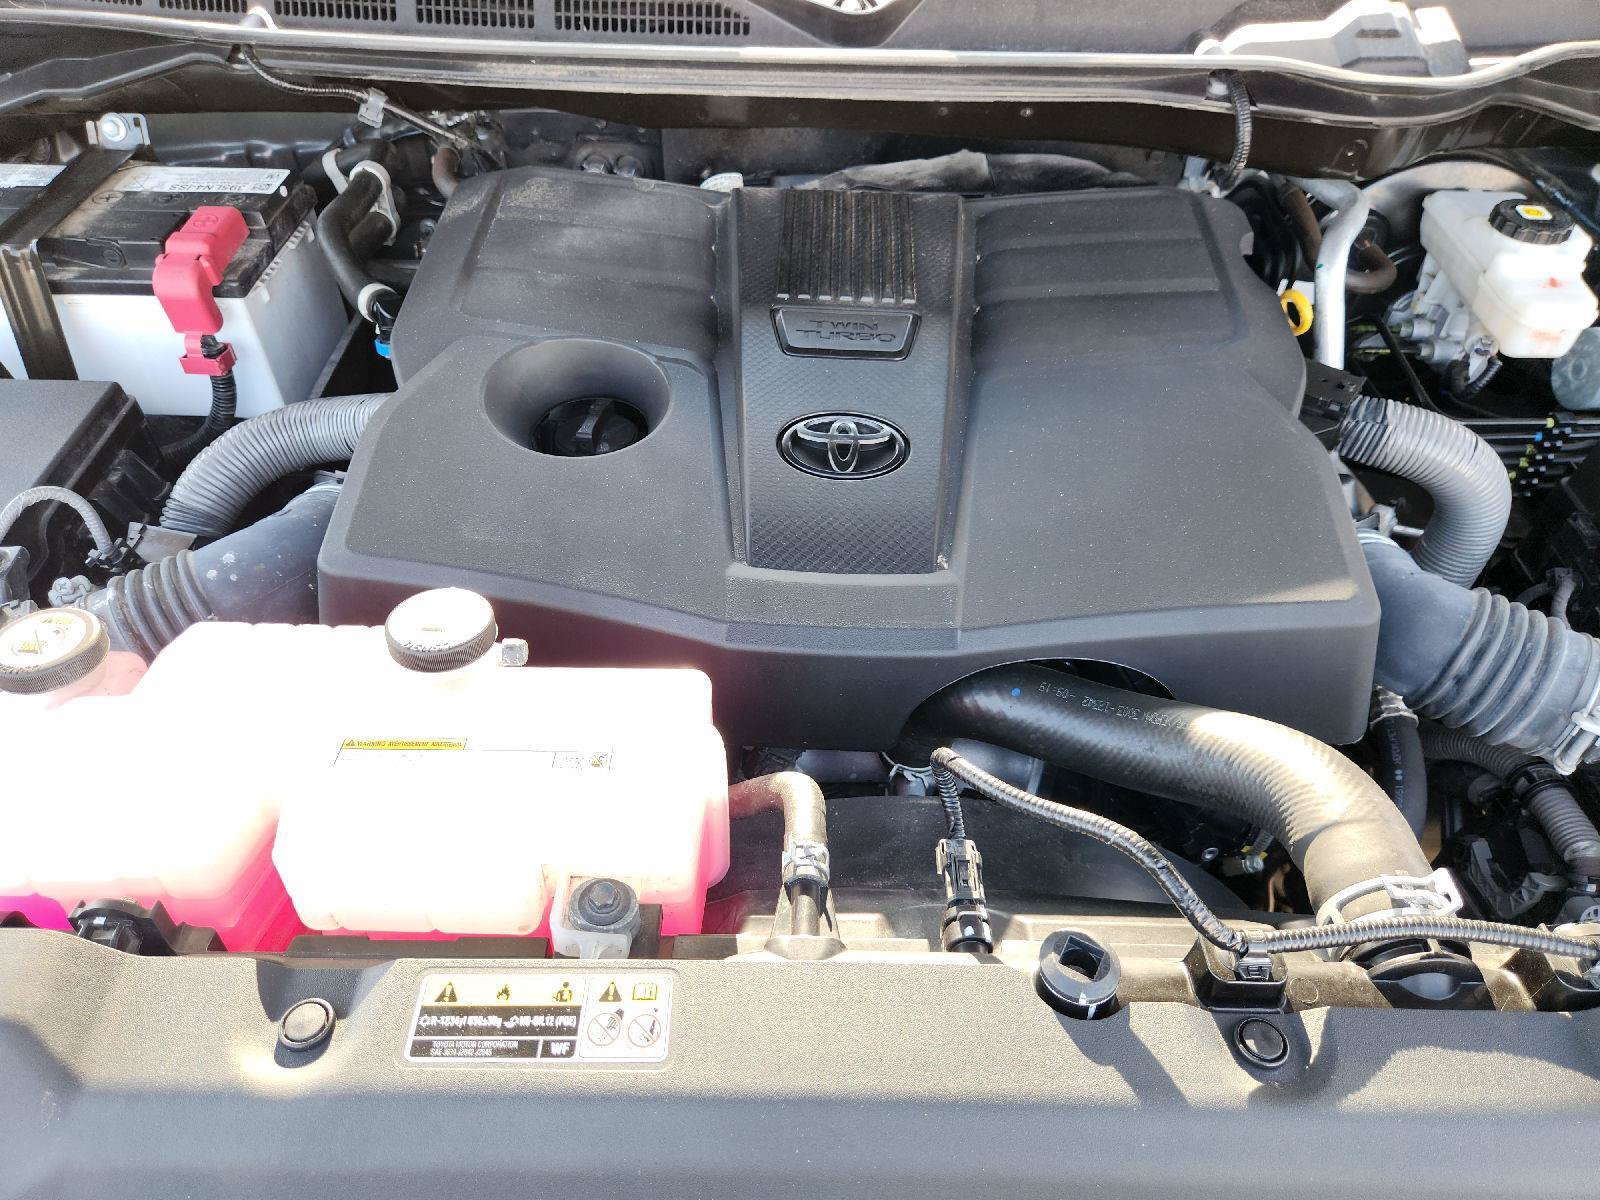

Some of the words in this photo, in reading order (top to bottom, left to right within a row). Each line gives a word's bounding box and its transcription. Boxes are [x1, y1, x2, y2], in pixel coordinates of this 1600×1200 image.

[809, 319, 878, 331] TWIN
[796, 329, 896, 342] TURBO
[432, 1040, 454, 1049] TOYOTA
[455, 1040, 477, 1049] MOTOR
[477, 1040, 519, 1050] CORPORATION
[551, 1041, 570, 1055] WF
[430, 1048, 442, 1056] SAE
